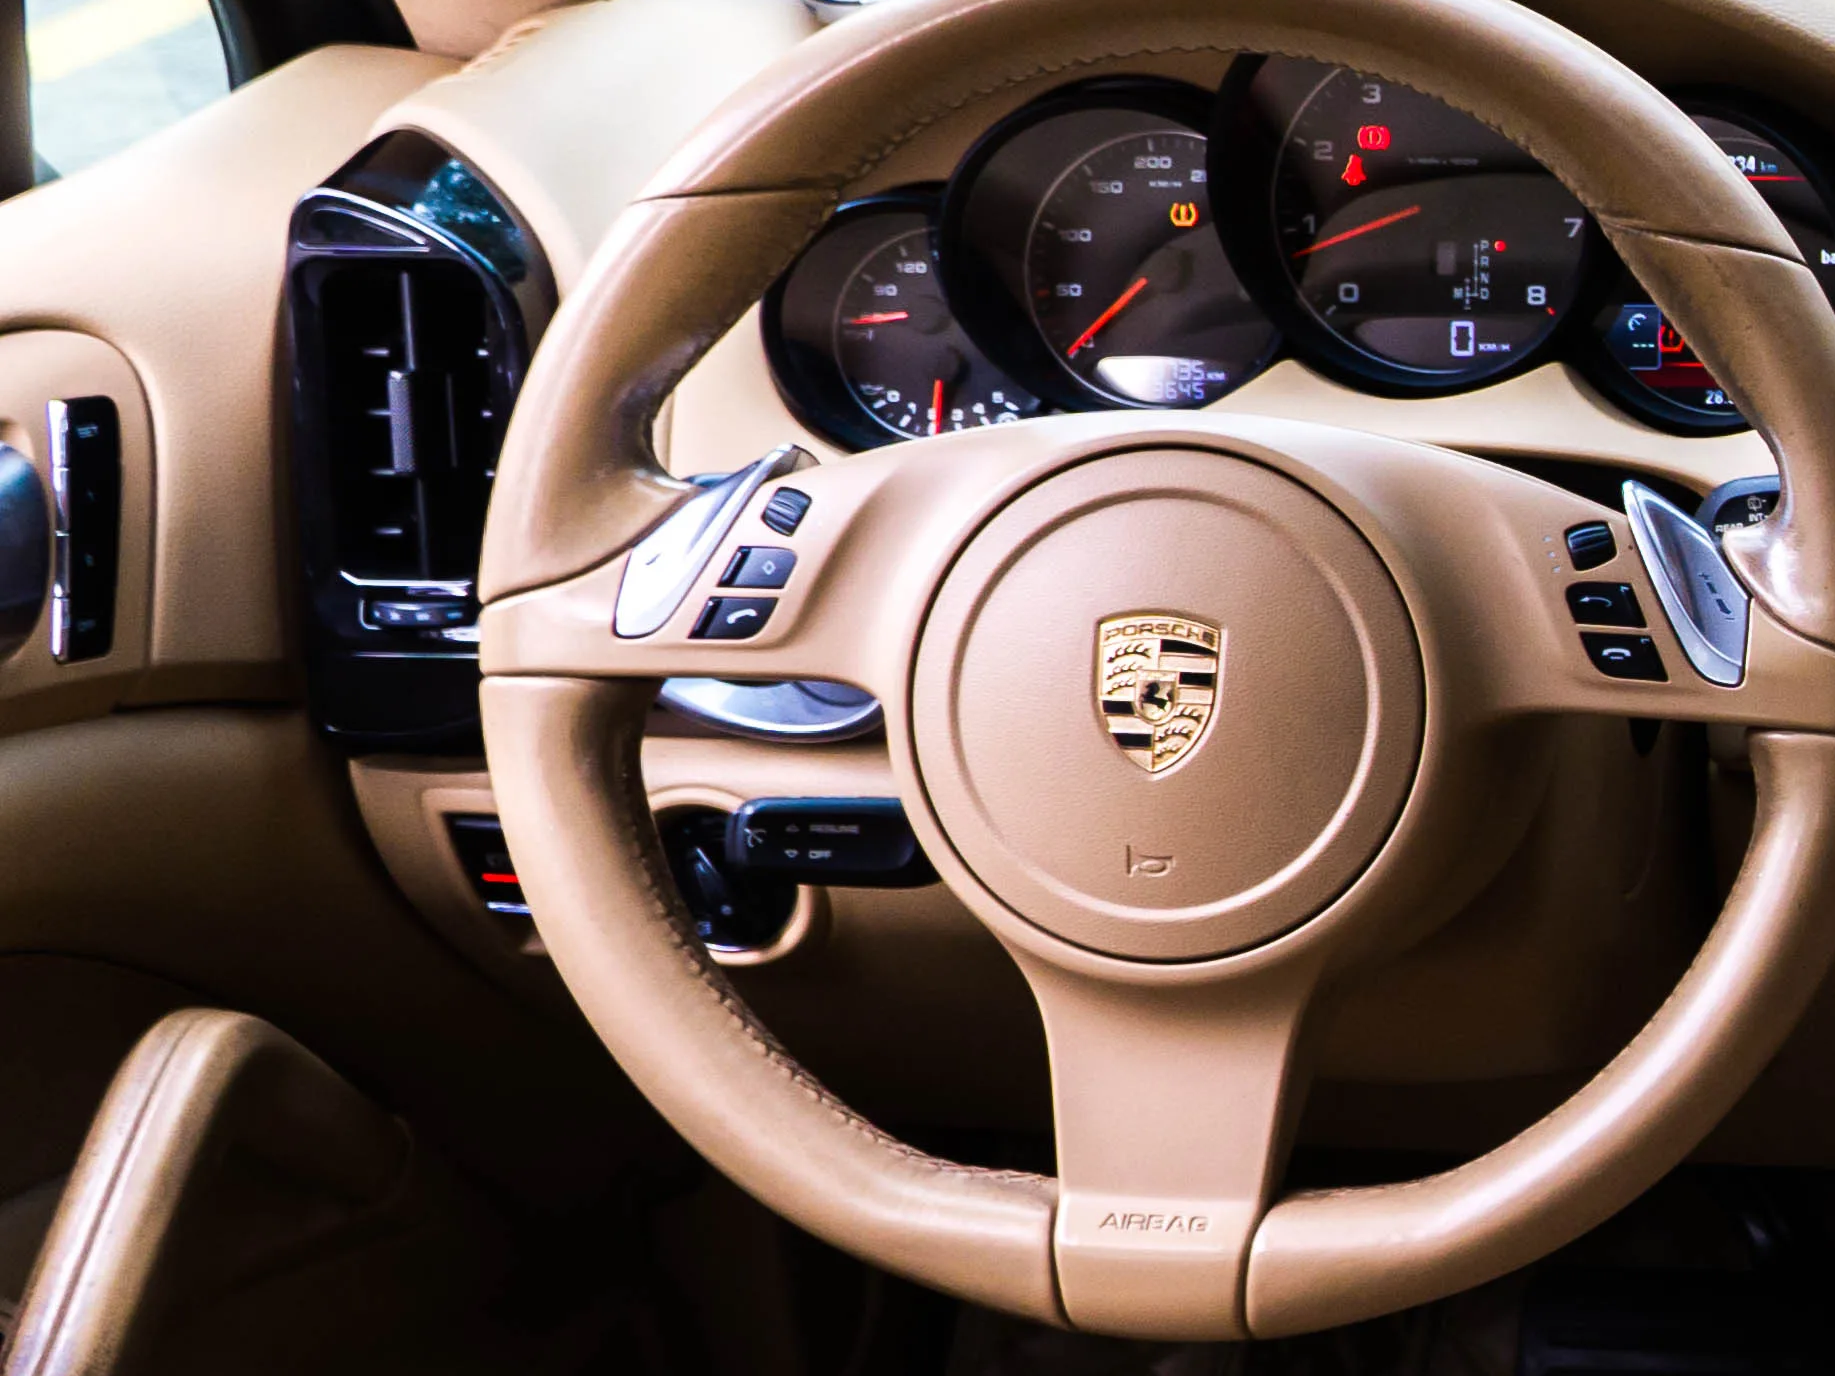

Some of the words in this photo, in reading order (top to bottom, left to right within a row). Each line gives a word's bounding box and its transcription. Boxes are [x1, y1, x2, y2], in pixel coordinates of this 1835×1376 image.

[1362, 84, 1382, 104] 3
[1313, 140, 1334, 161] 2
[1302, 214, 1316, 234] 1
[1564, 217, 1584, 238] 7
[1338, 282, 1360, 303] 0
[1526, 285, 1547, 306] 8
[1450, 320, 1475, 357] 0
[1105, 622, 1216, 647] PORSCHE
